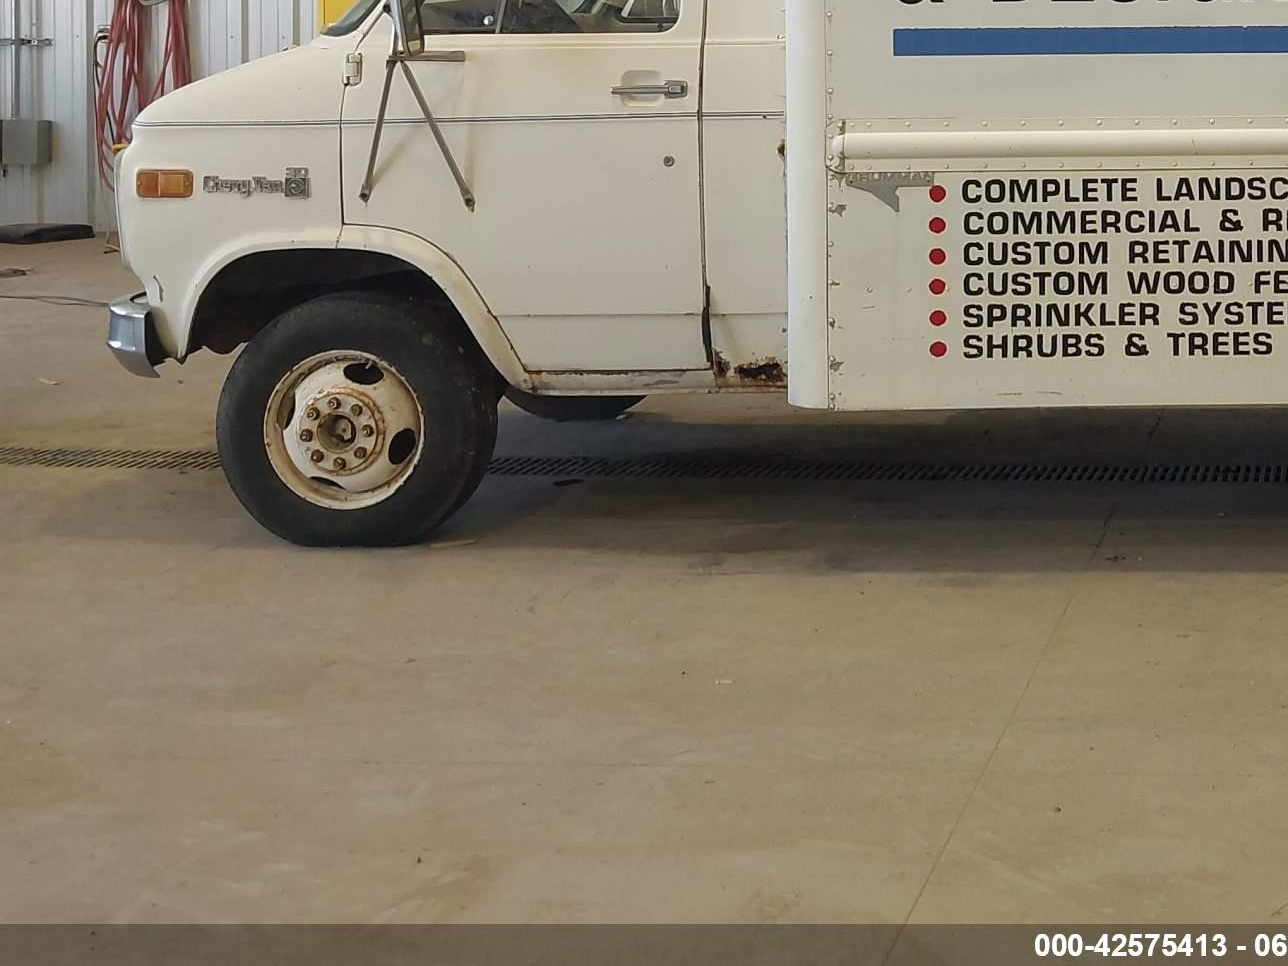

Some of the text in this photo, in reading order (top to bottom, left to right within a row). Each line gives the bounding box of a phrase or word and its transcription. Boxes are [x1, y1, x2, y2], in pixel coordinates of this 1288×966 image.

[962, 178, 1137, 203] COMPLETE
[964, 209, 1200, 235] COMMERCIAL
[1220, 209, 1243, 232] &
[964, 242, 1108, 265] CUSTOM
[964, 272, 1107, 296] CUSTOM
[1127, 271, 1234, 294] WOOD
[964, 302, 1159, 327] SPRINKLER
[963, 332, 1272, 358] SHRUBS & TREES
